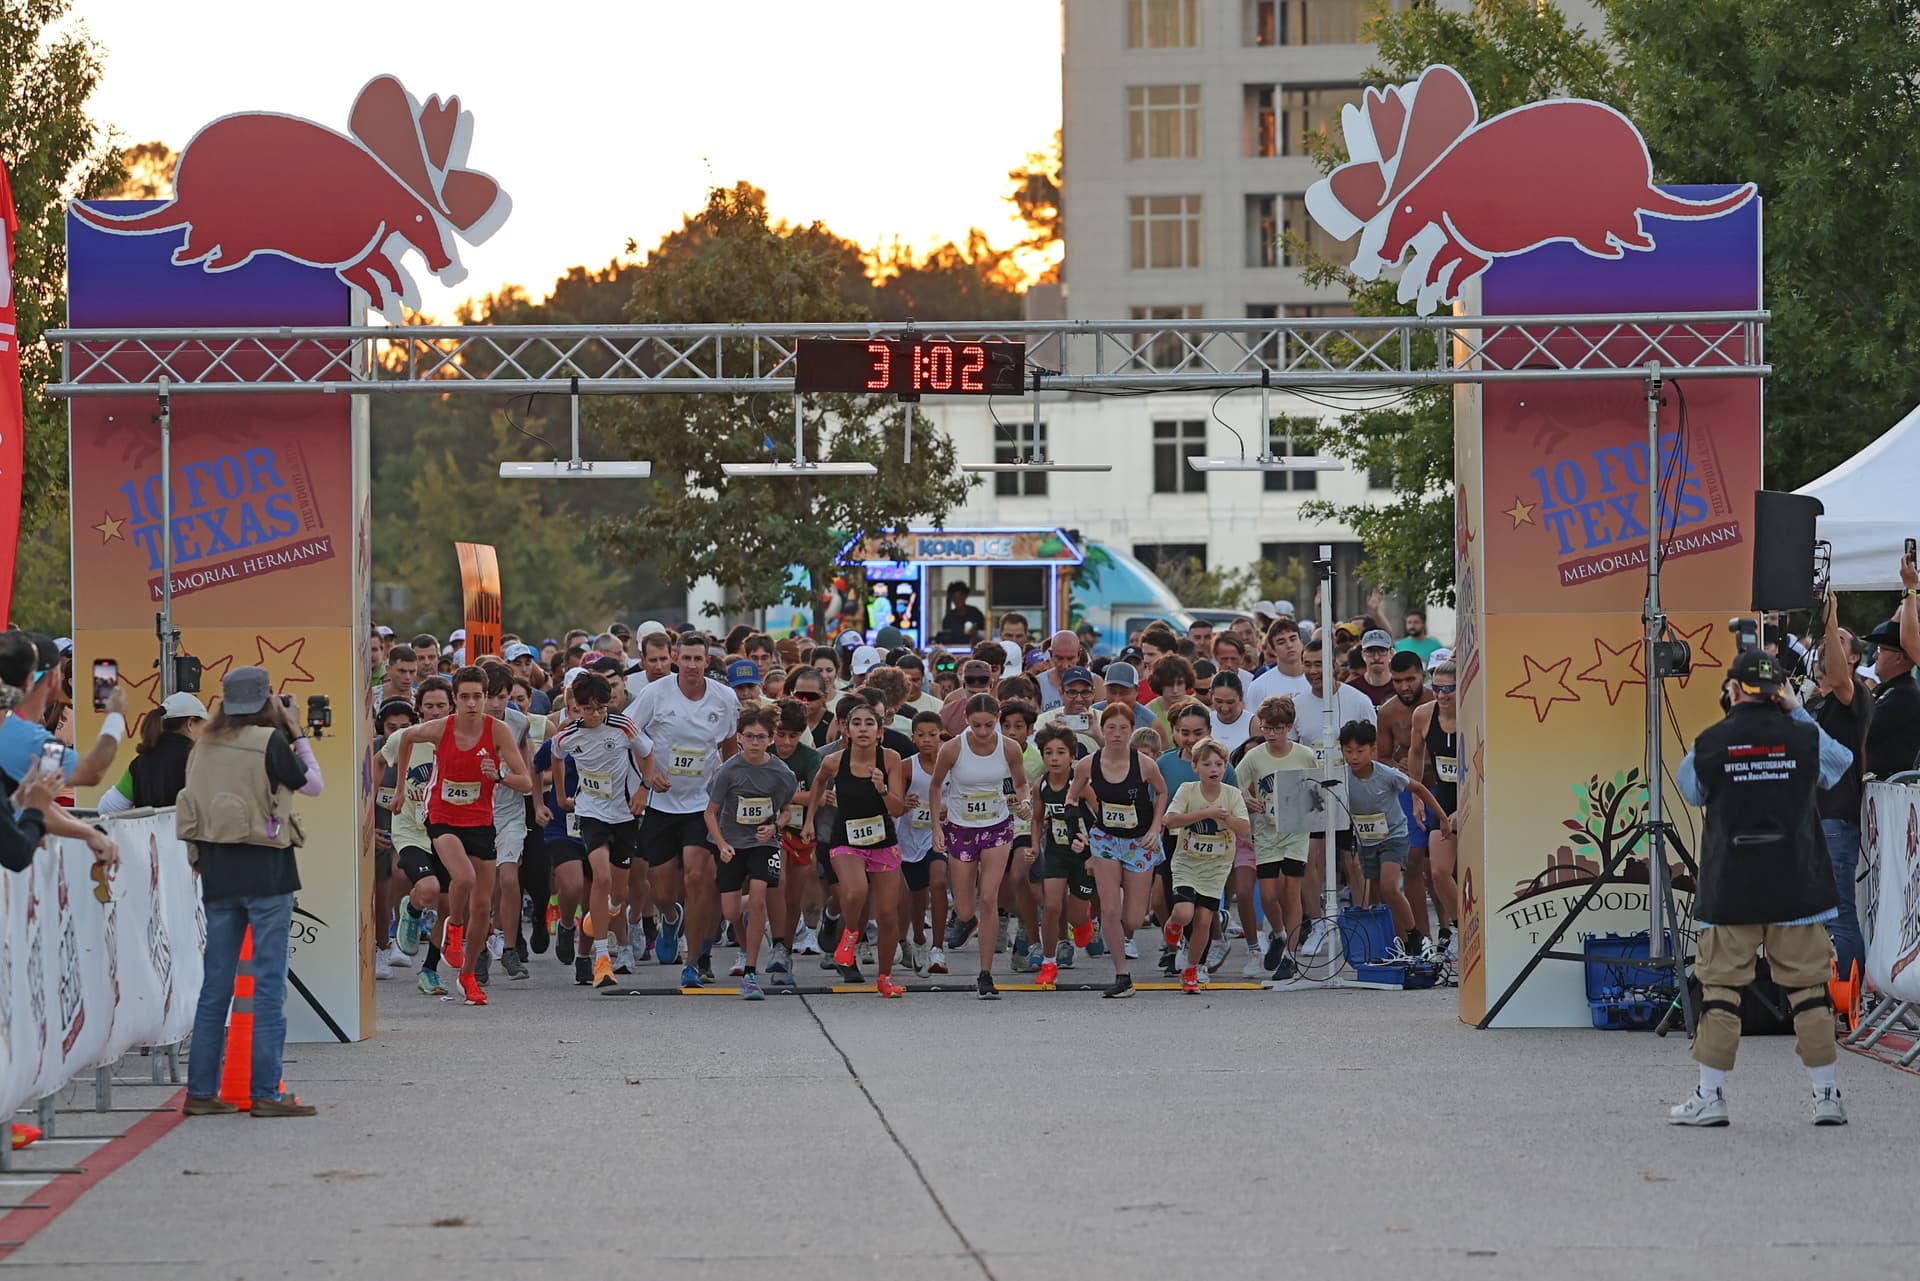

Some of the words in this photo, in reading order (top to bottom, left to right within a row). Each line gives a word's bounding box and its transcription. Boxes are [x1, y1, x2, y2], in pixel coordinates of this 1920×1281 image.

[1530, 459, 1587, 510] 10
[1591, 431, 1696, 496] FOR
[119, 473, 176, 525] 10
[179, 447, 286, 510] FOR
[1542, 477, 1709, 557] TEXAS
[132, 492, 299, 571] TEXAS
[917, 538, 975, 557] KONA
[979, 537, 1011, 556] ICE
[154, 564, 239, 597] MEMORIAL
[242, 540, 328, 574] HERMANN
[1564, 549, 1648, 582] MEMORIAL
[674, 756, 694, 768] 197
[1724, 761, 1749, 772] OFFICIAL
[1750, 759, 1797, 770] PHOTOGRAPHER
[447, 788, 469, 798] 245
[742, 806, 762, 817] 185
[967, 802, 987, 813] 541
[1105, 811, 1126, 822] 278
[853, 827, 873, 839] 316
[1357, 823, 1375, 833] 287
[1193, 842, 1214, 853] 478
[1506, 900, 1558, 930] THE
